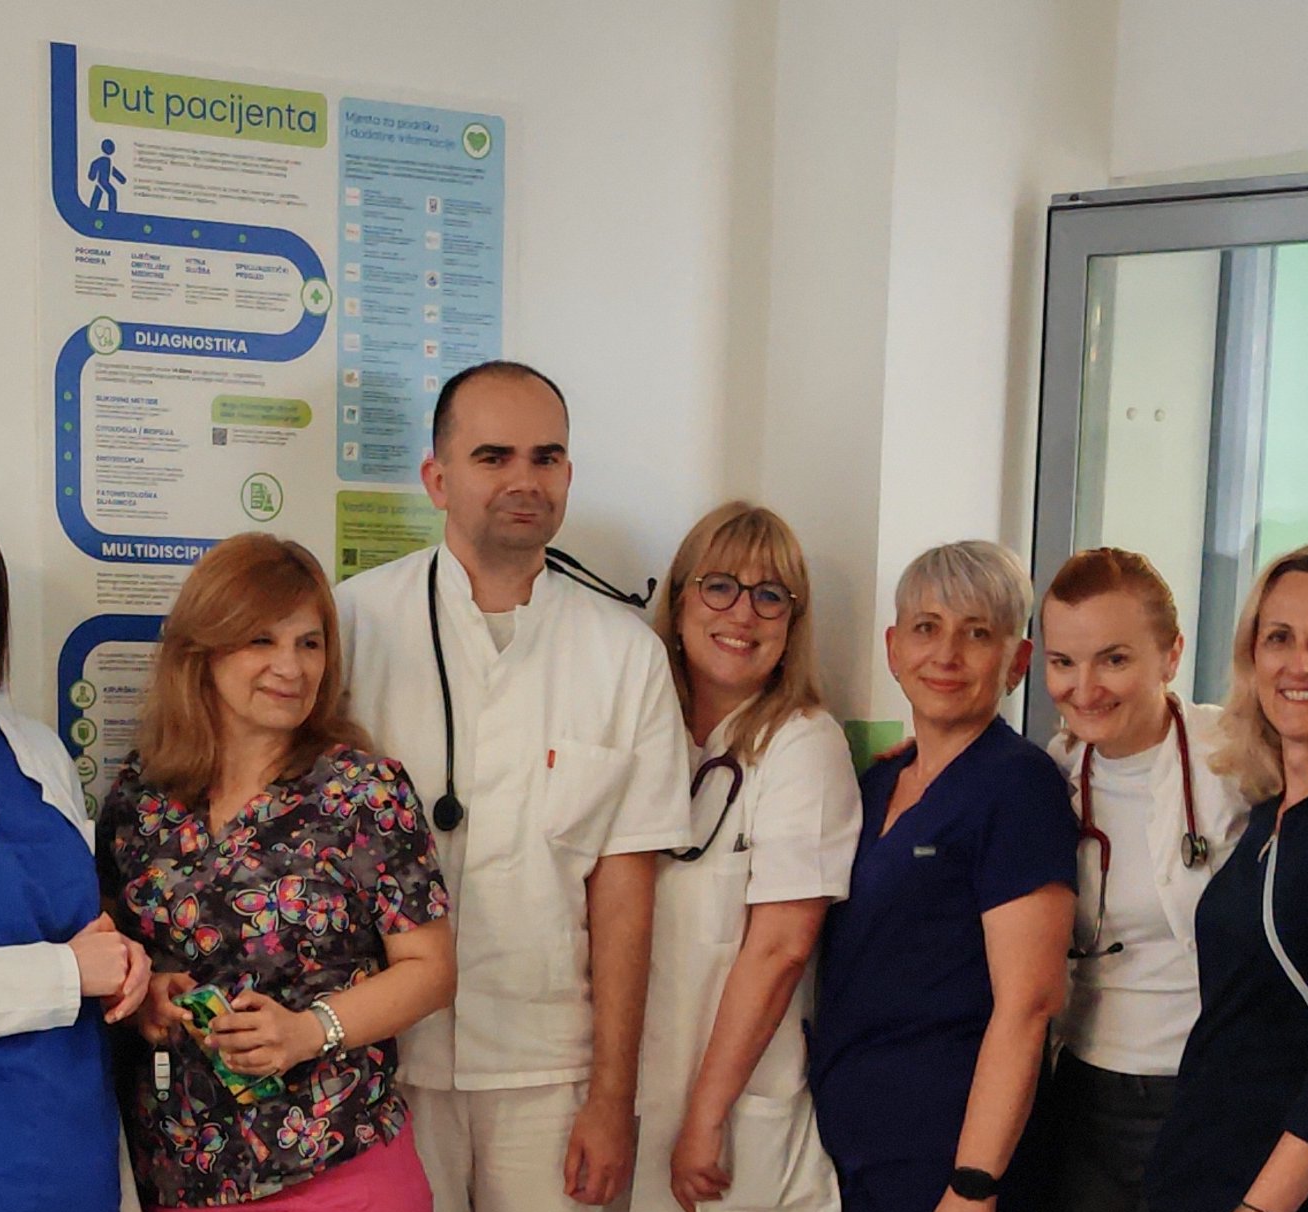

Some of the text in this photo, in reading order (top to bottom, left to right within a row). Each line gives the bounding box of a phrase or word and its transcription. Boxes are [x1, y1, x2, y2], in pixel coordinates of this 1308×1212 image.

[103, 79, 317, 135] Put pacijenta
[135, 331, 248, 354] DIJAGNOSTIKA
[101, 542, 210, 560] MULTIDISCIP
